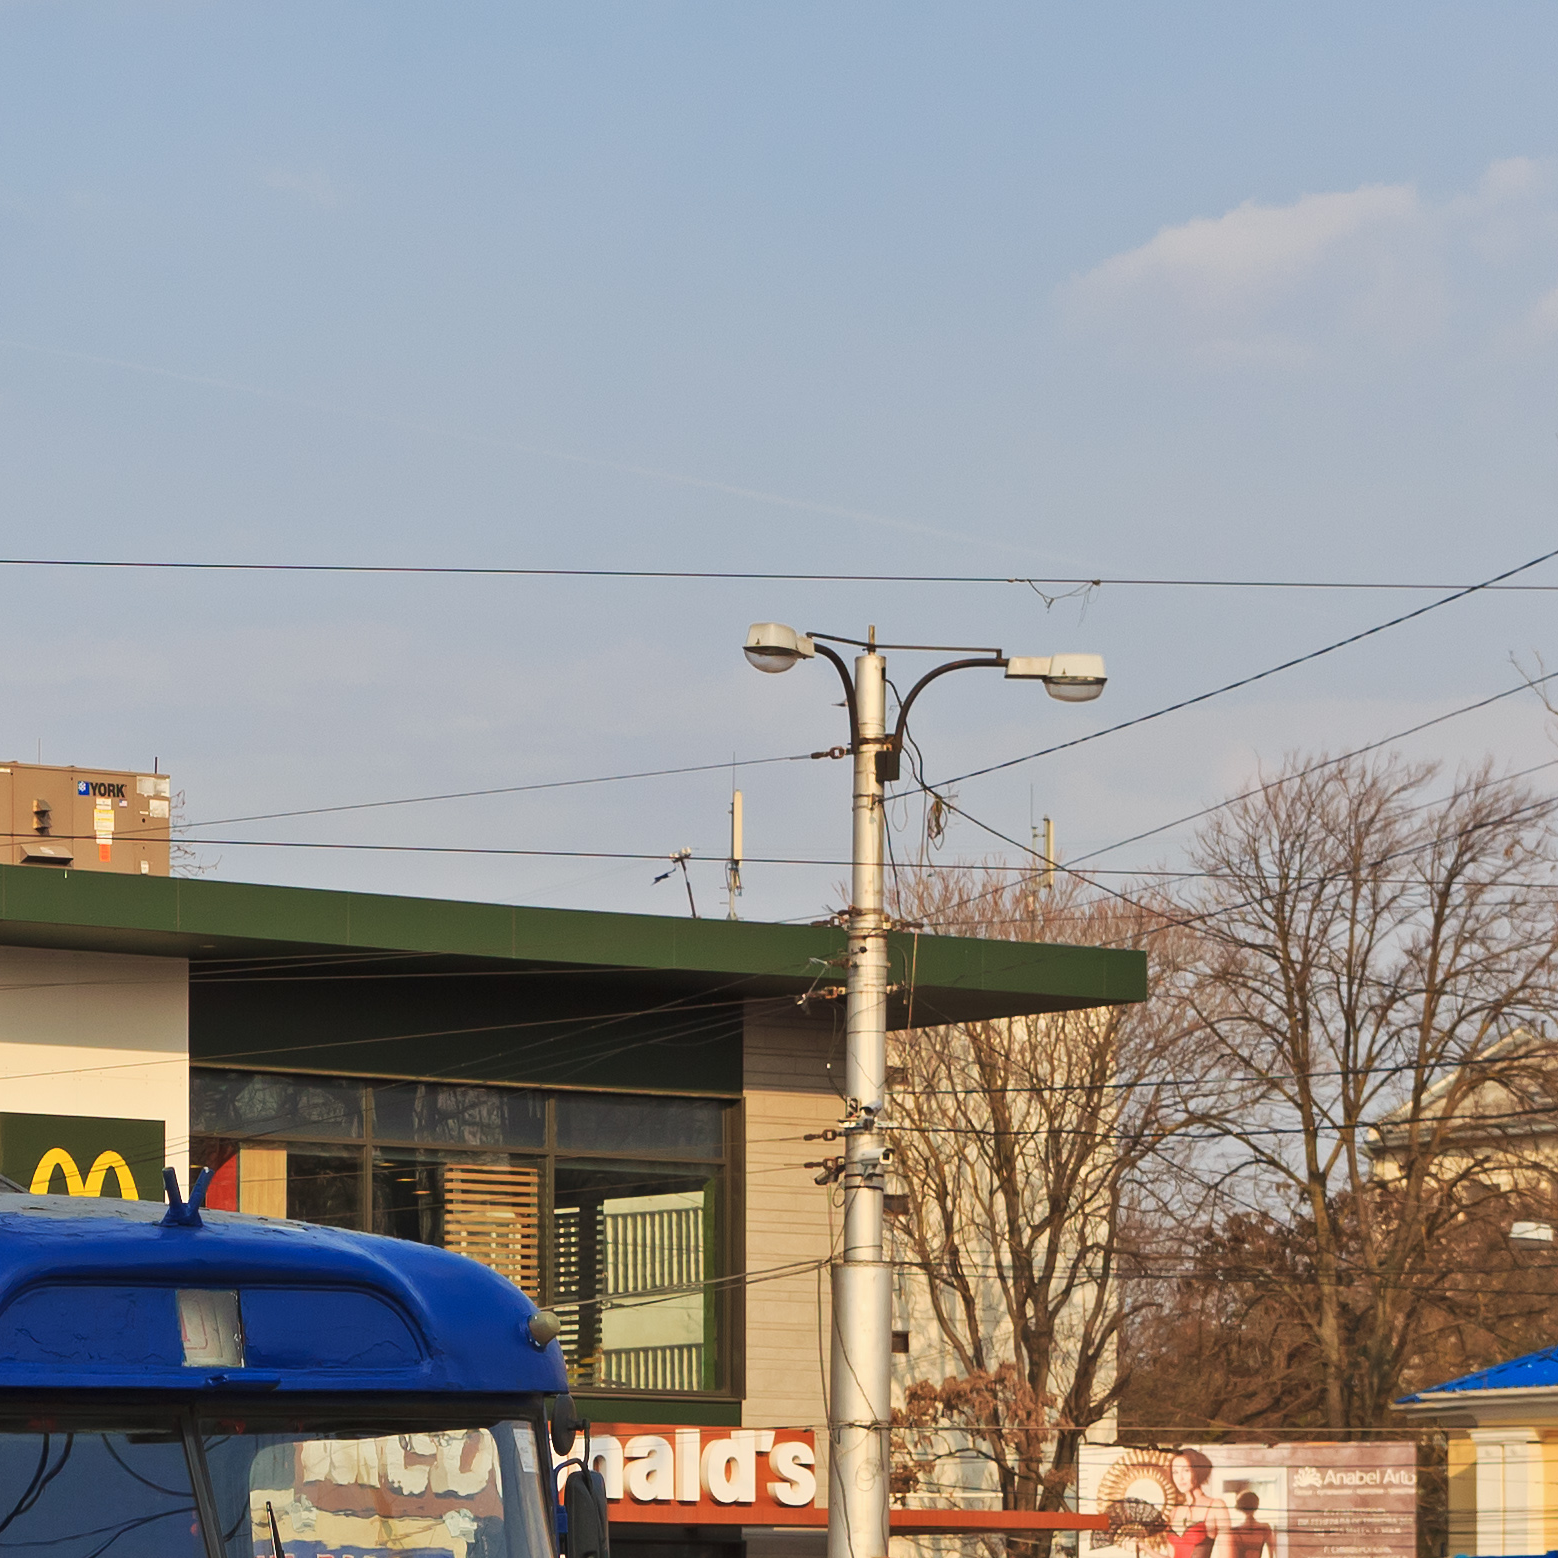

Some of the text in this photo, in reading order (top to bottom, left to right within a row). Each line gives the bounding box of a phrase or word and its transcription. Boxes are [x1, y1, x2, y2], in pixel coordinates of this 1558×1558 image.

[90, 782, 125, 798] YORK
[1323, 1468, 1417, 1485] Anabel Arto
